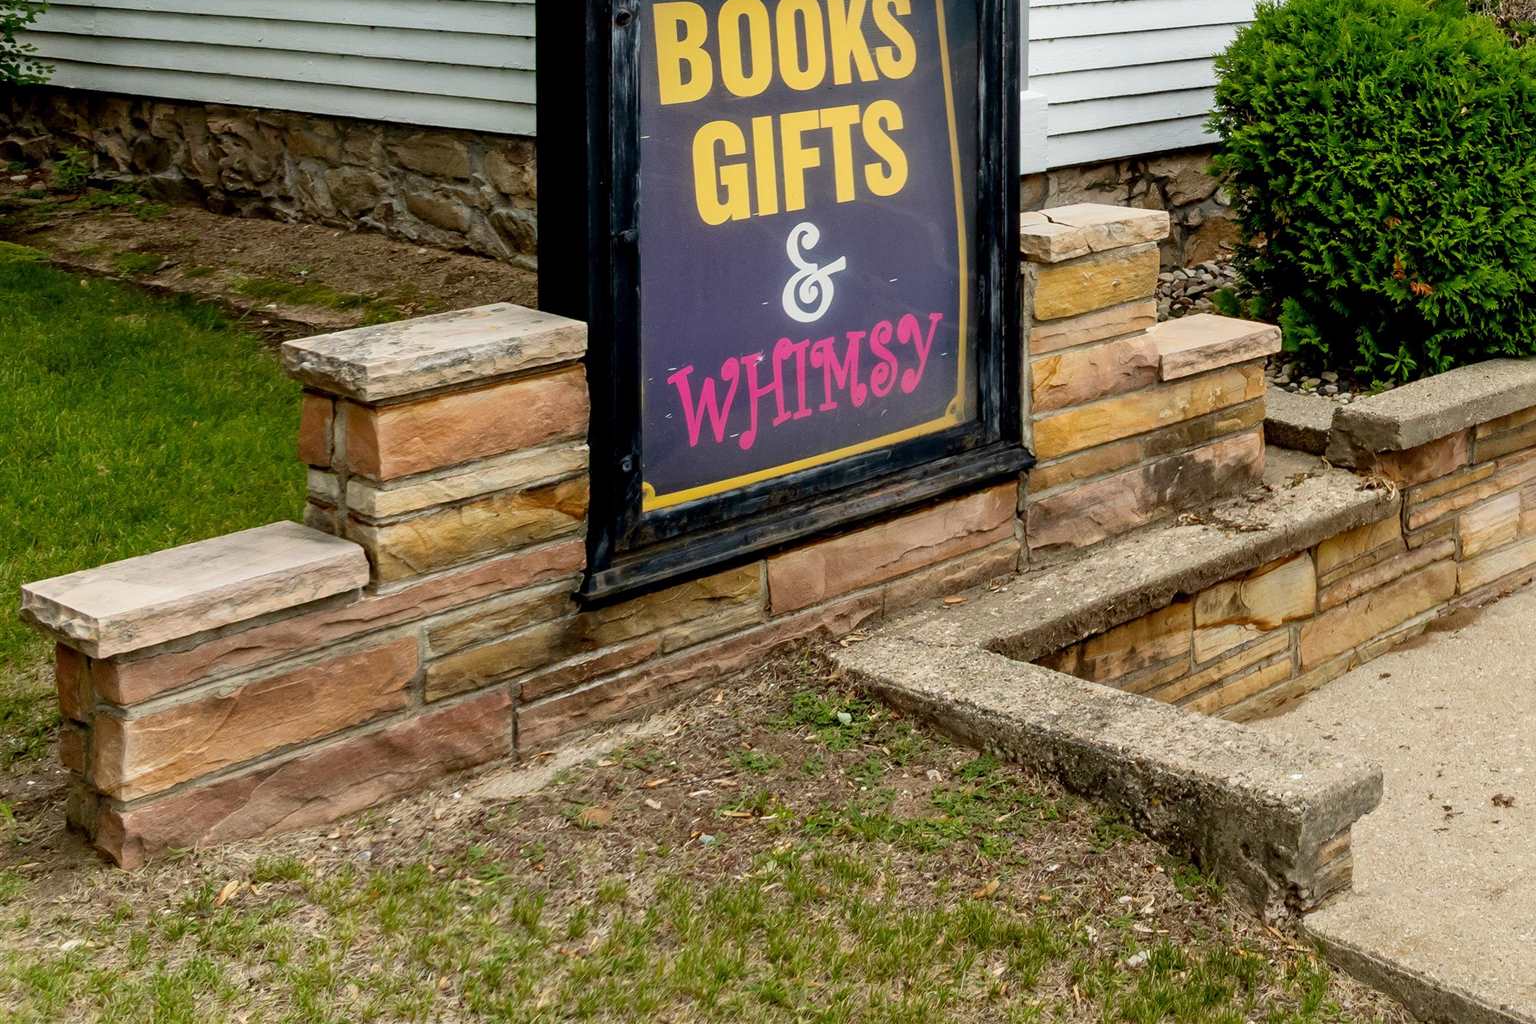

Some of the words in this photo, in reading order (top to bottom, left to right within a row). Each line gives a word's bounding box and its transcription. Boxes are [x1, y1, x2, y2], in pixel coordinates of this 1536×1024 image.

[692, 99, 909, 226] GIFTS
[782, 222, 847, 323] &
[667, 312, 943, 450] WHIMSY
